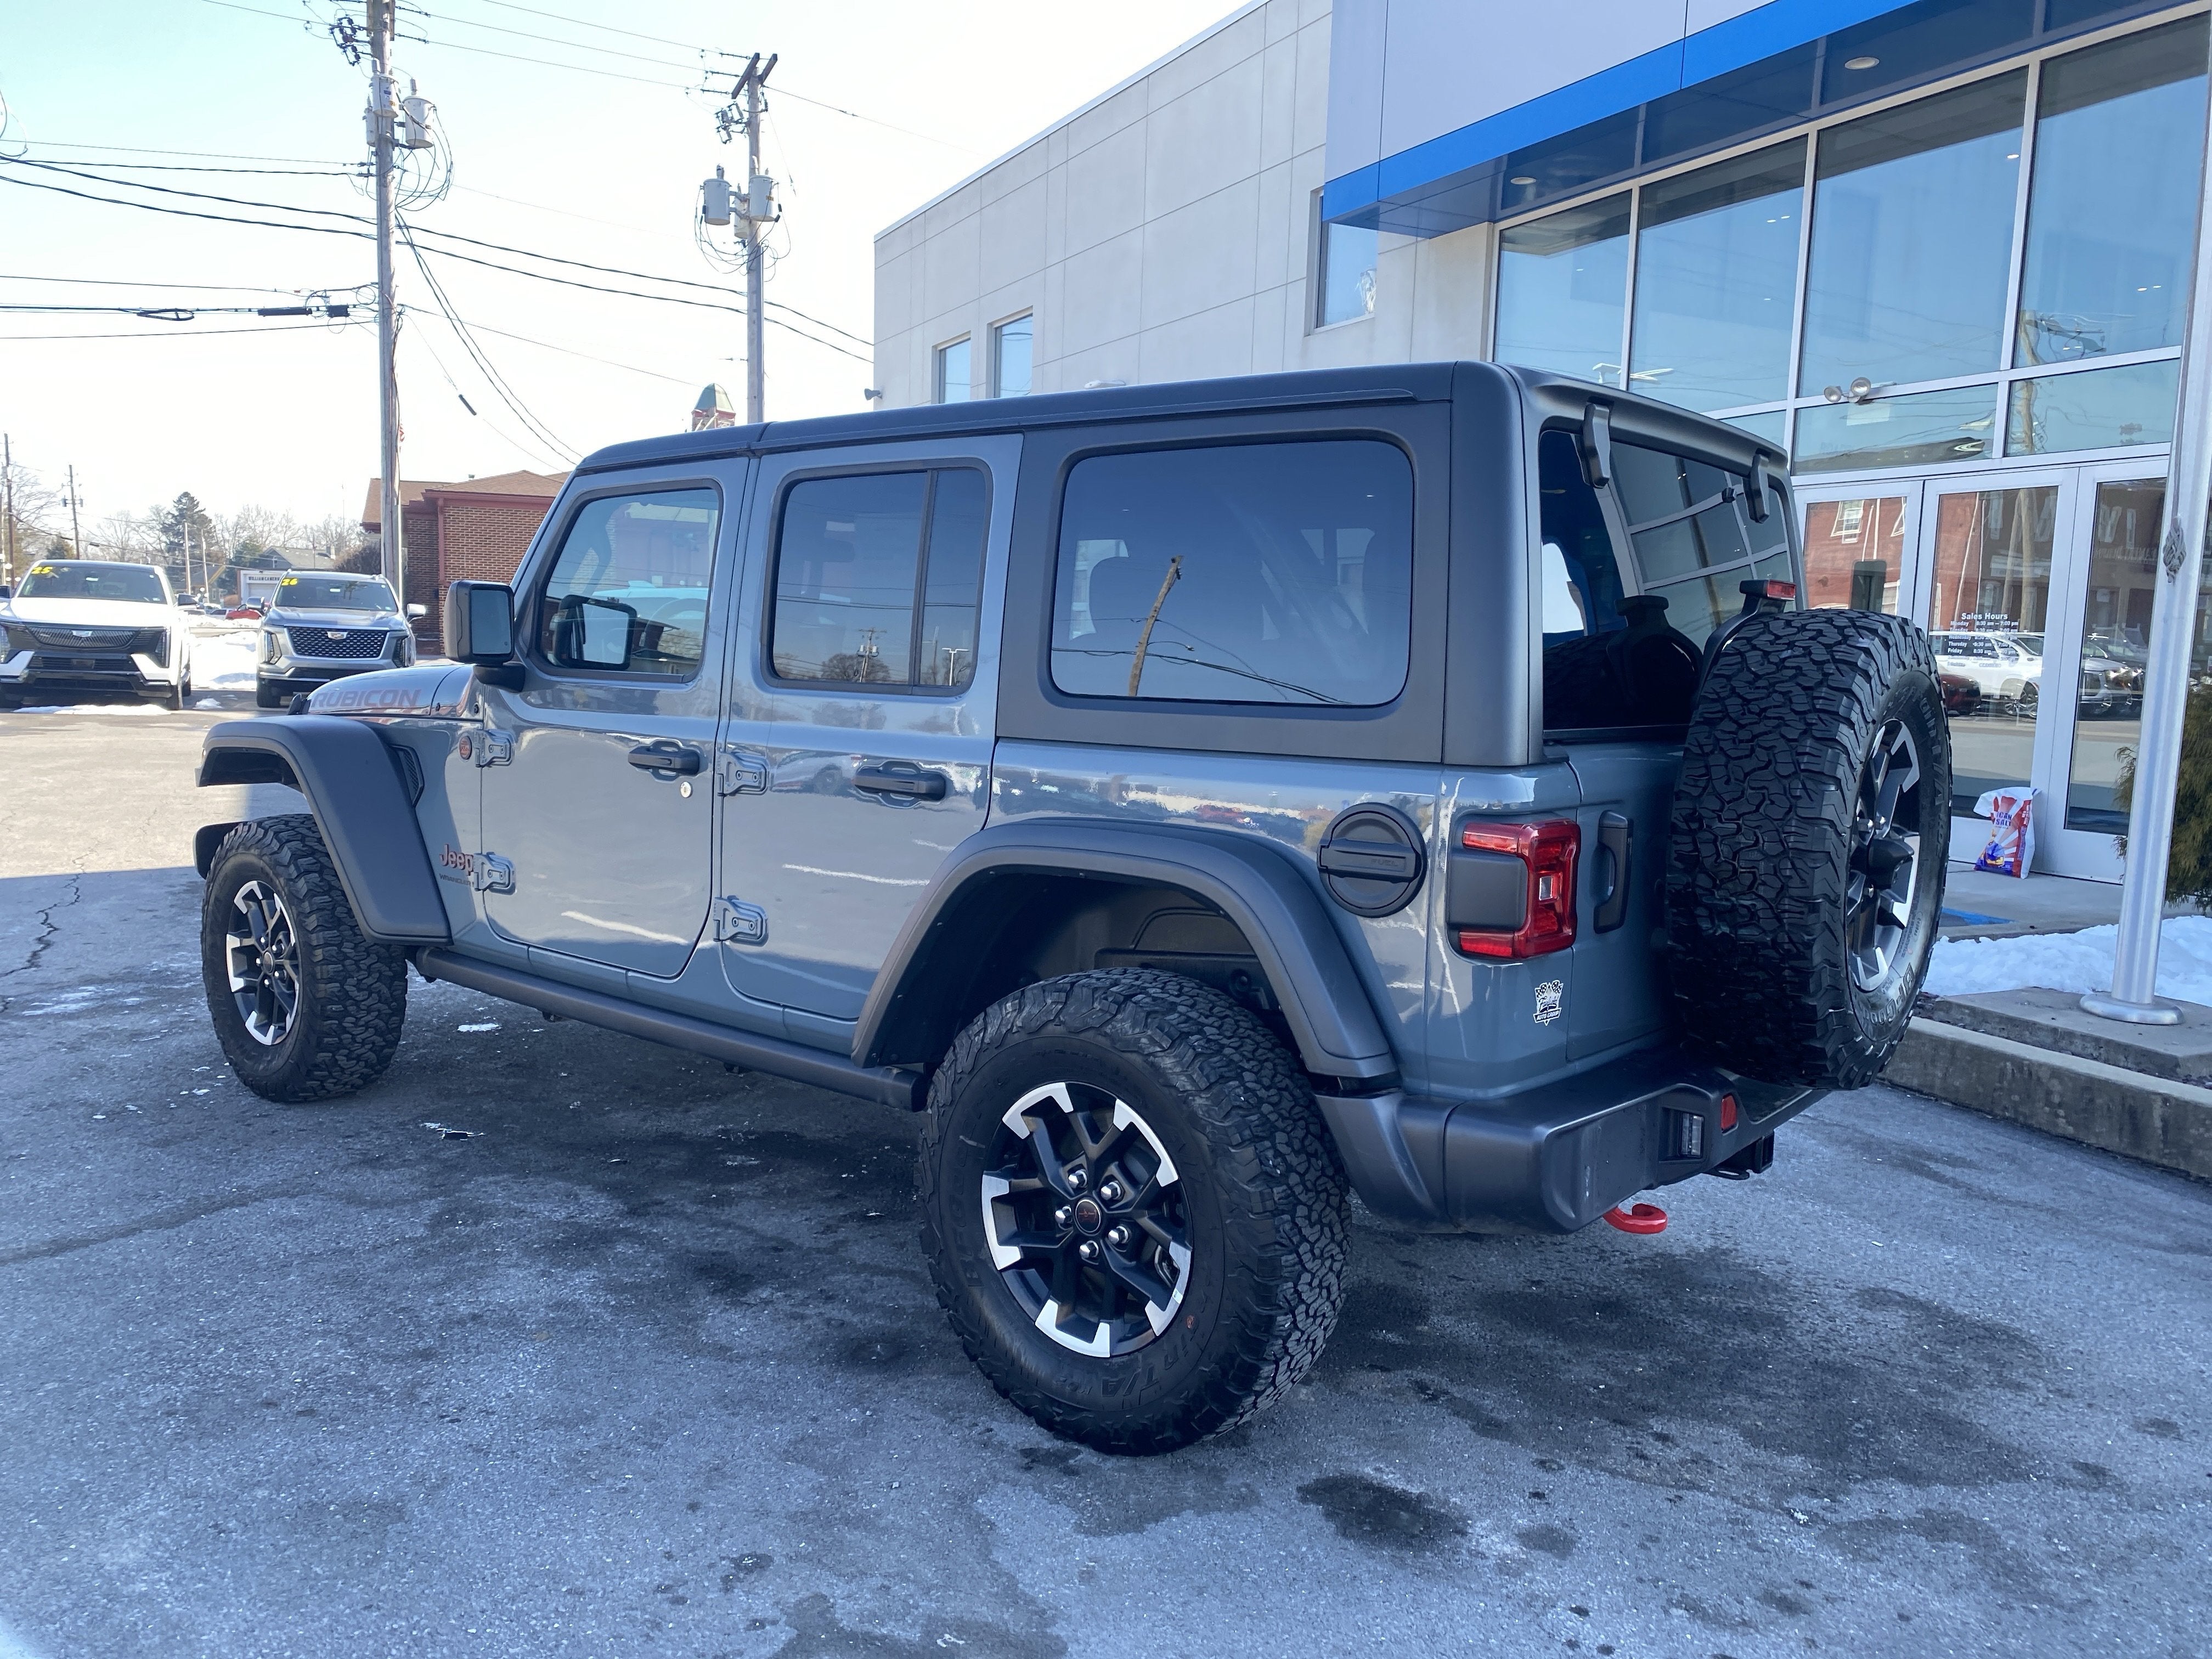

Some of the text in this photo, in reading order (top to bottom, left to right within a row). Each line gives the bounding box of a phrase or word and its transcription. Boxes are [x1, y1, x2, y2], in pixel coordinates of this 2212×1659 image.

[31, 566, 53, 574] 25
[281, 578, 298, 586] 26
[311, 689, 422, 708] RUBICON
[439, 843, 473, 877] Jeep
